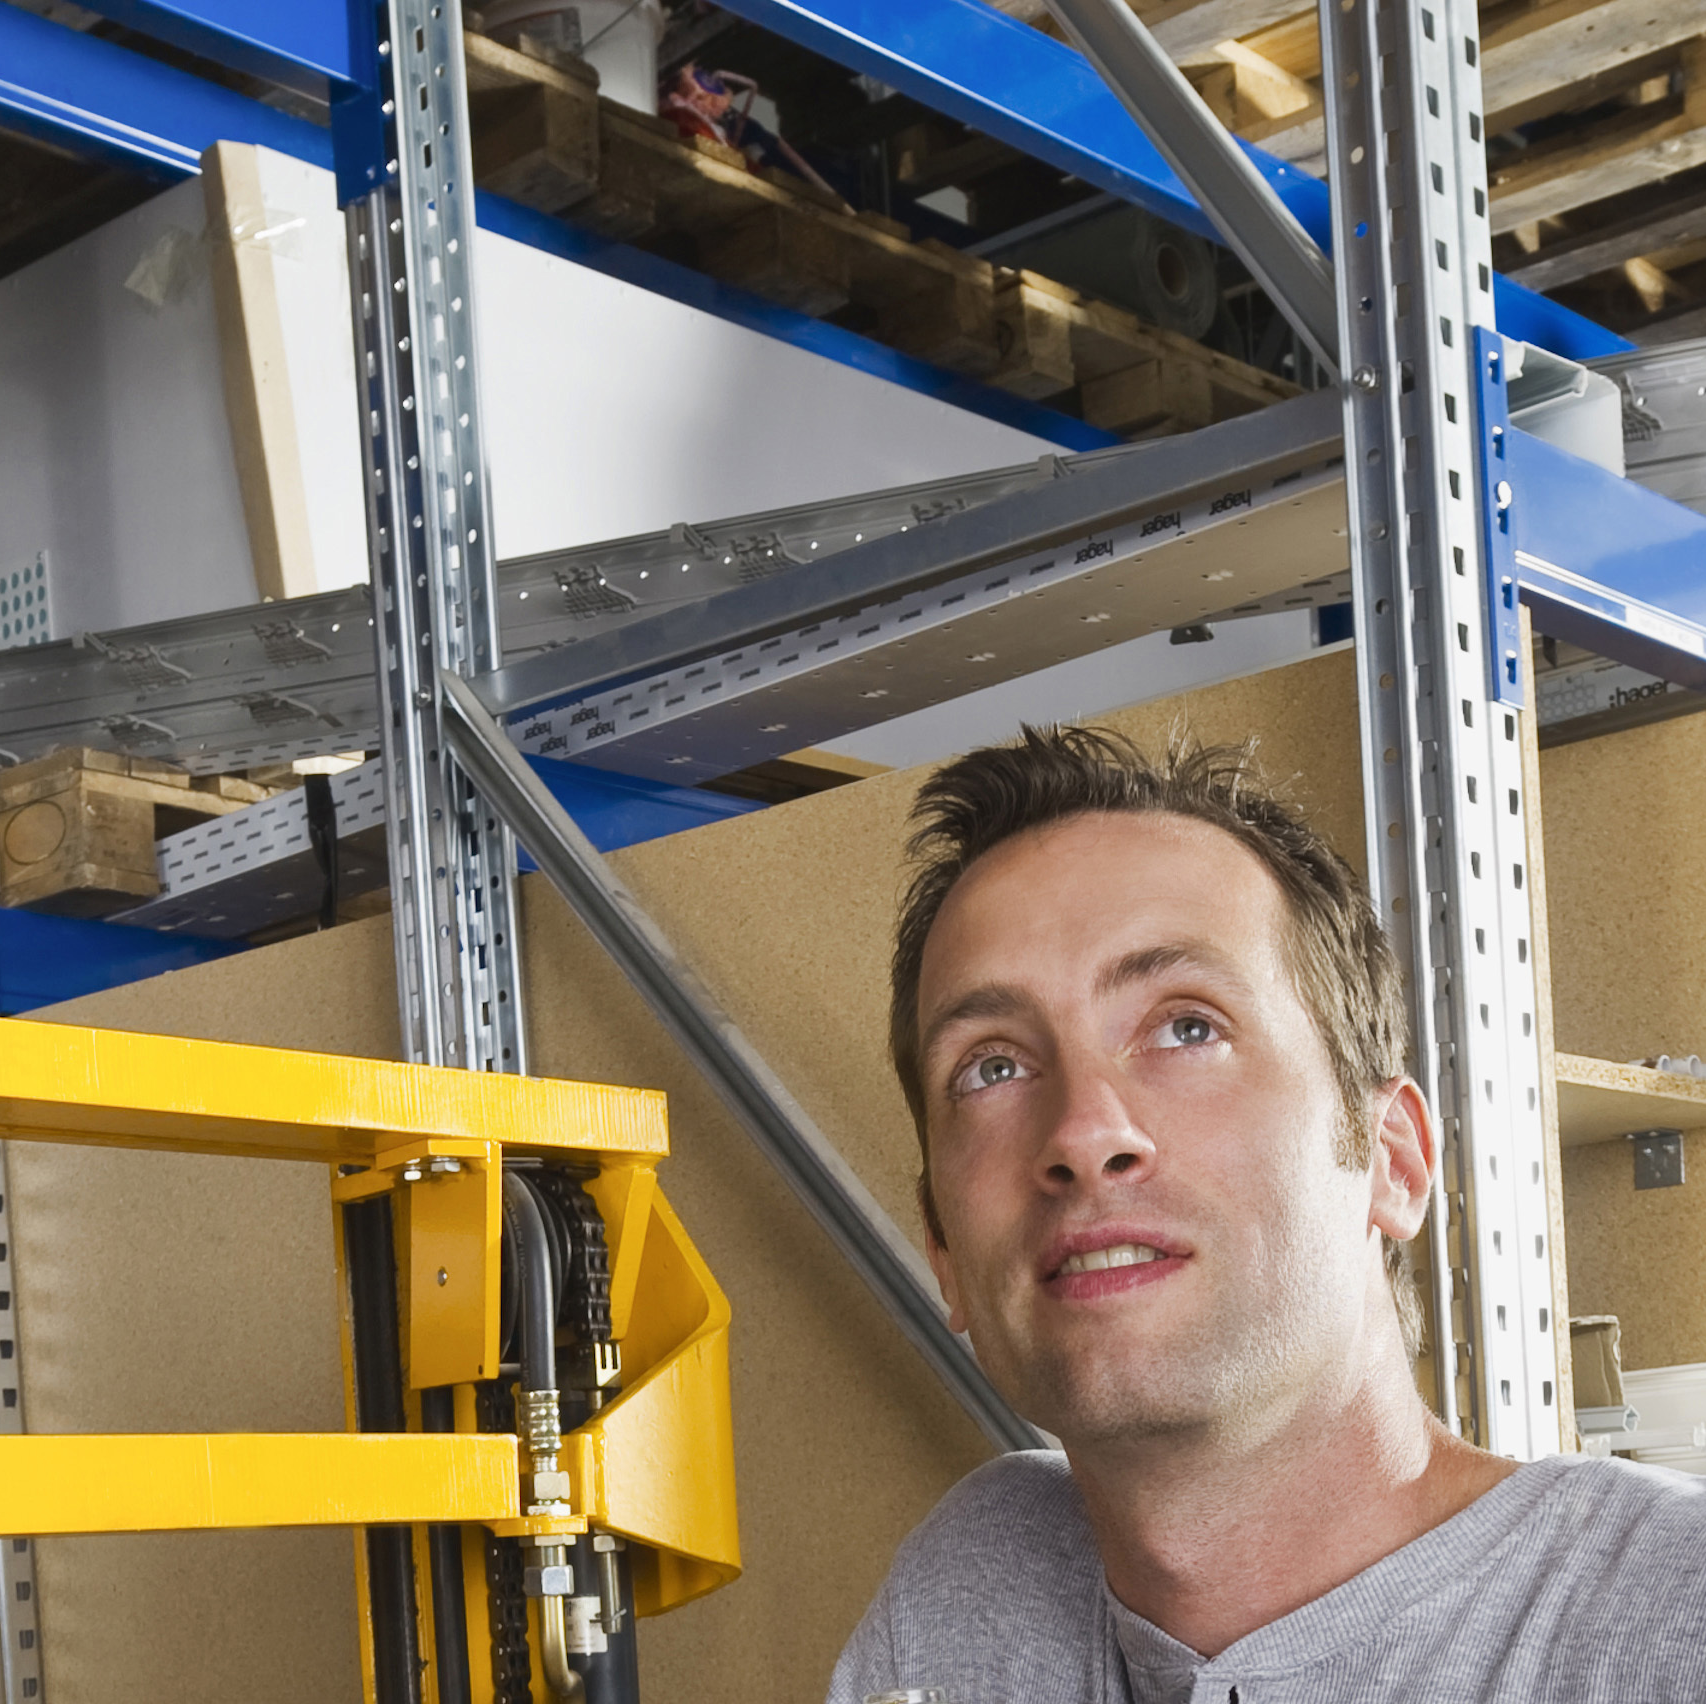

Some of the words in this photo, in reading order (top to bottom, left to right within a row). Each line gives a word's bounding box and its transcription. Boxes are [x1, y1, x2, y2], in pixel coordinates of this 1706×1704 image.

[1209, 489, 1252, 516] hager
[1140, 511, 1181, 538] hager
[1074, 539, 1114, 565] hager
[570, 706, 600, 727] hager
[586, 720, 616, 741] hager
